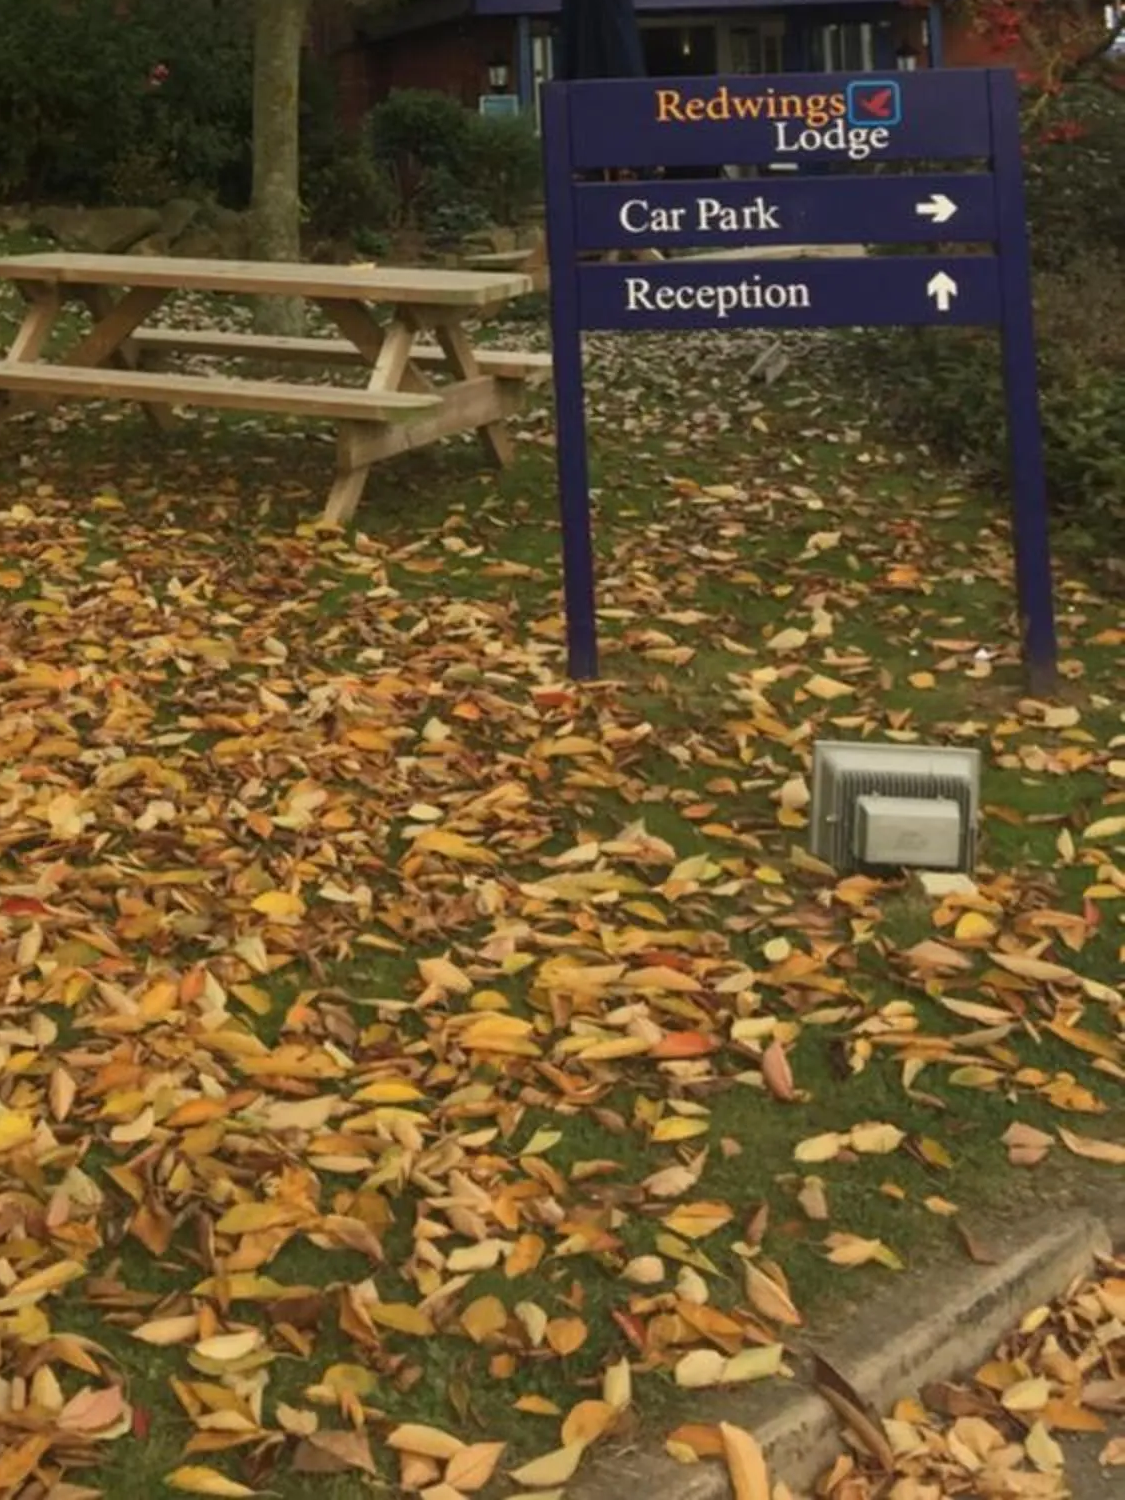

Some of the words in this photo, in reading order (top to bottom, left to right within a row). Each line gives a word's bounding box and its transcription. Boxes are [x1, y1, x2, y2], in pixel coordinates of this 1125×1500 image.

[655, 86, 847, 128] Redwings
[774, 118, 890, 160] Lodge
[619, 199, 686, 233] Car
[696, 197, 781, 231] Park
[624, 274, 811, 318] Reception
